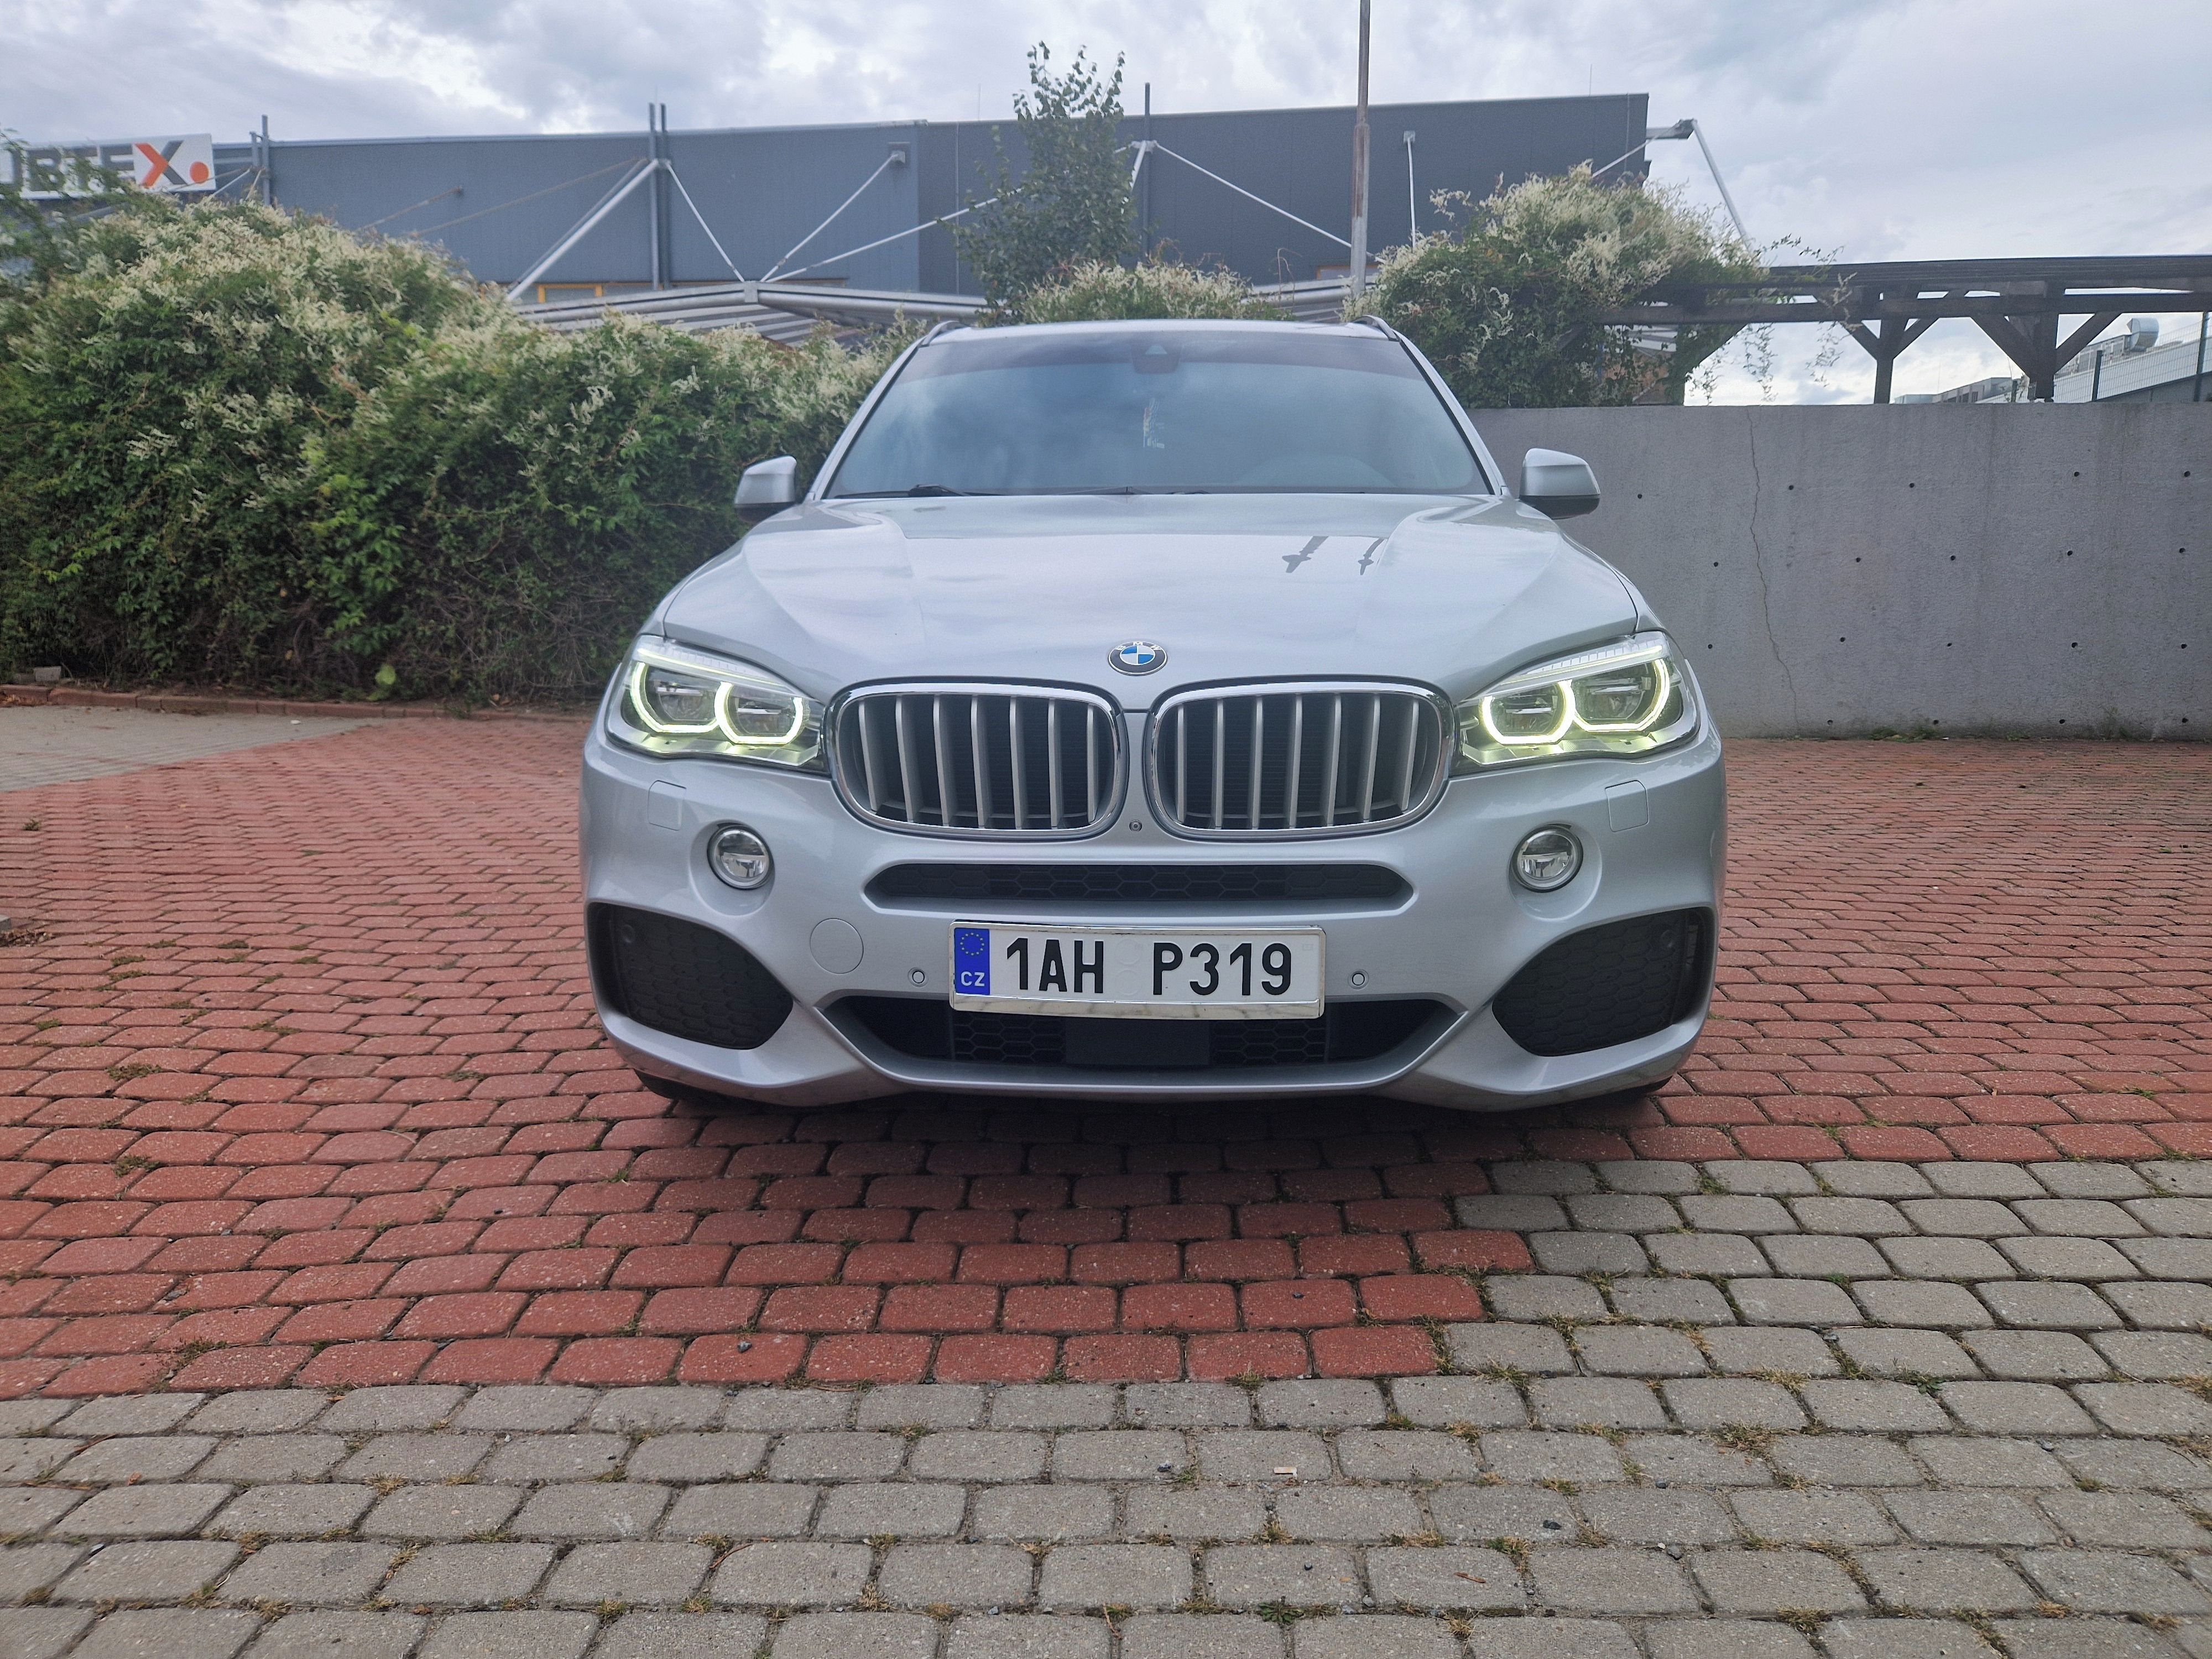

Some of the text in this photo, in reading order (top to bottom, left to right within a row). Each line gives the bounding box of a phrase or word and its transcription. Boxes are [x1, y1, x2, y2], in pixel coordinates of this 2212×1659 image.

[1116, 641, 1162, 651] BMW
[1007, 938, 1292, 996] 1AH P319
[961, 971, 986, 987] CZ
